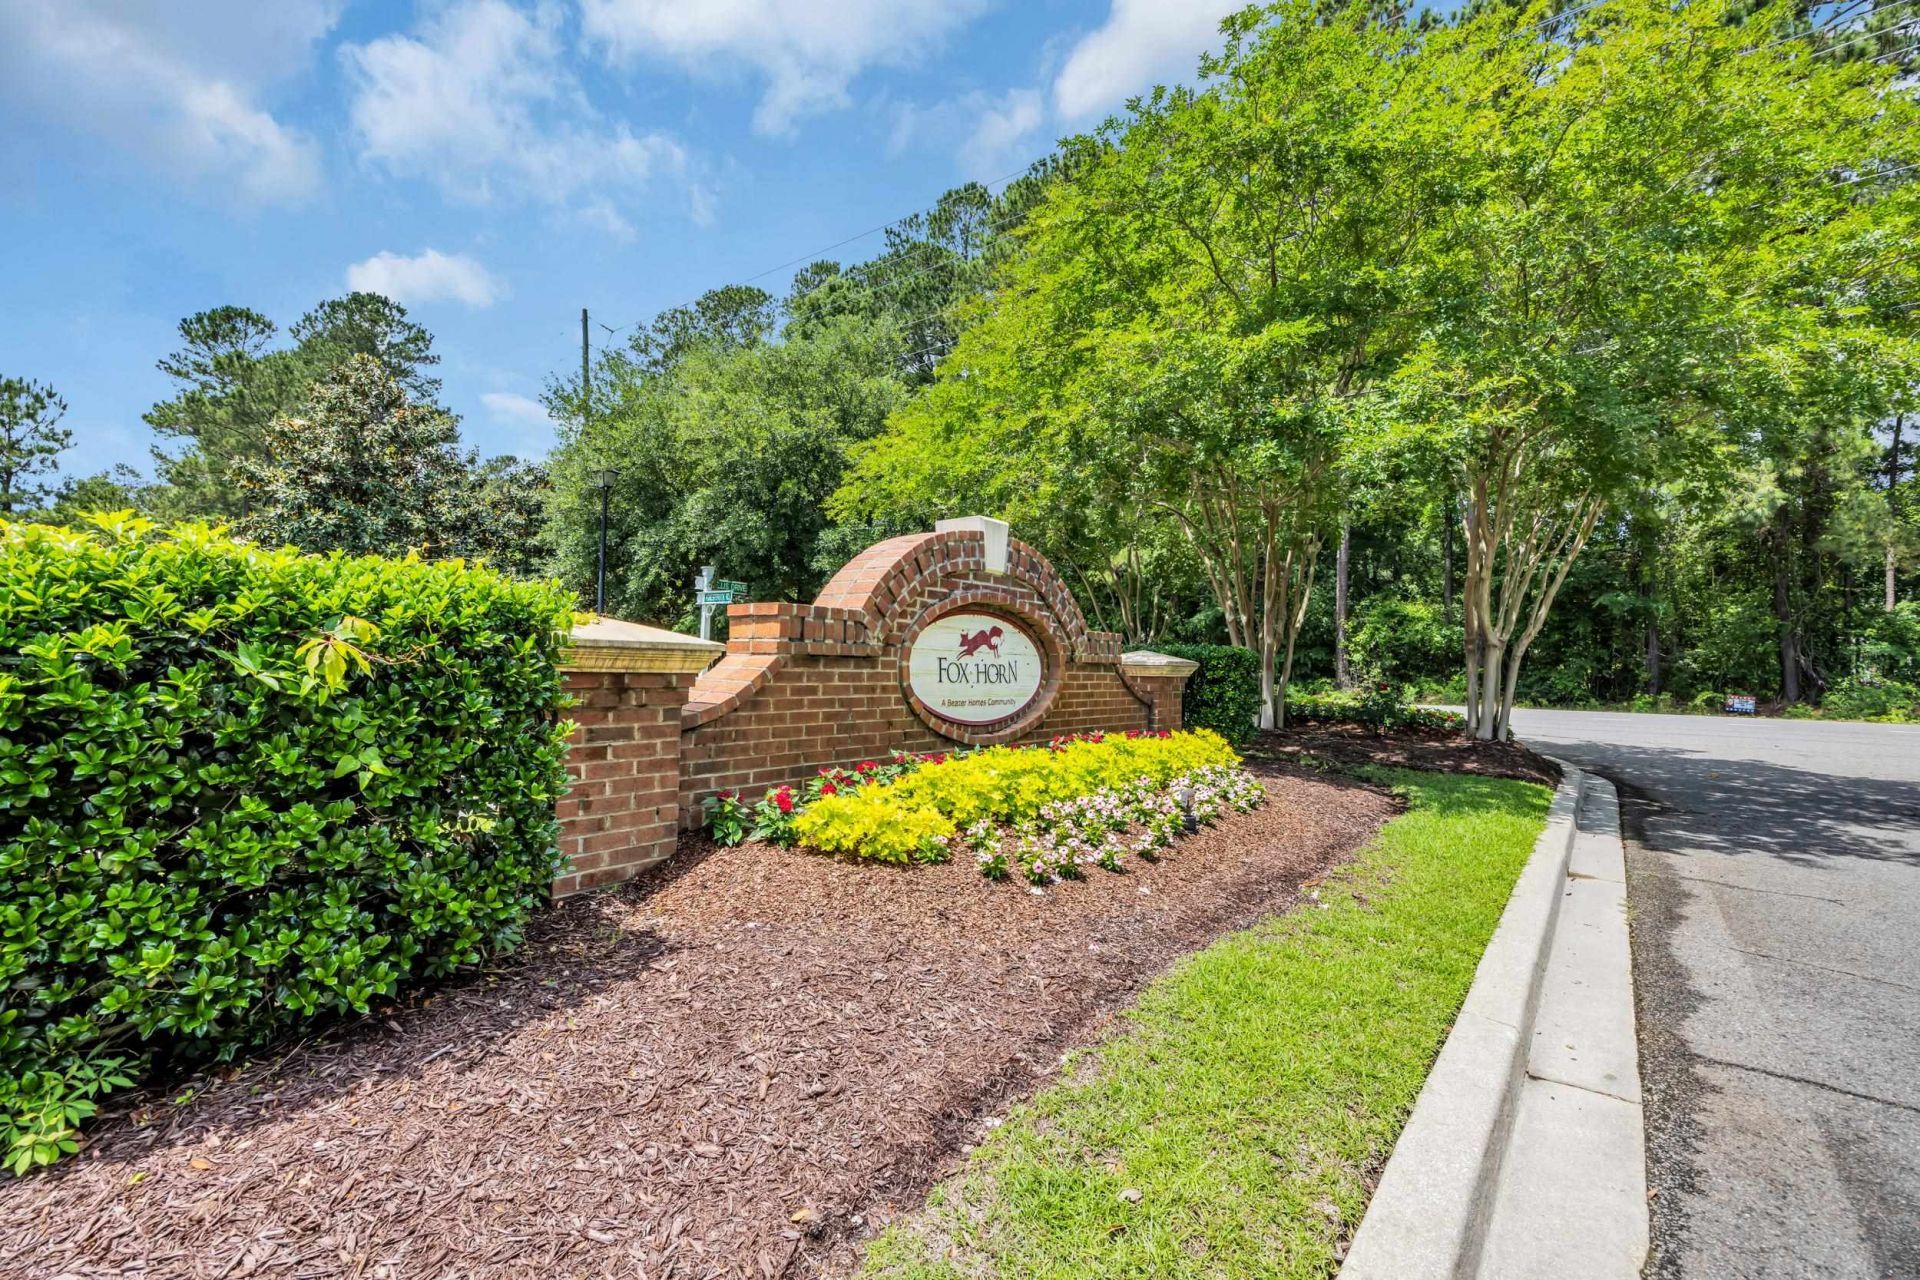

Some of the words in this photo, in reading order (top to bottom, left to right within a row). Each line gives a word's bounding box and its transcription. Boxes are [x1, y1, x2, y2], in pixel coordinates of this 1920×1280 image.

[937, 657, 969, 684] FOX
[975, 660, 1018, 684] HORN
[947, 699, 967, 707] Beazer
[968, 699, 986, 707] Homes
[987, 698, 1016, 707] Community
